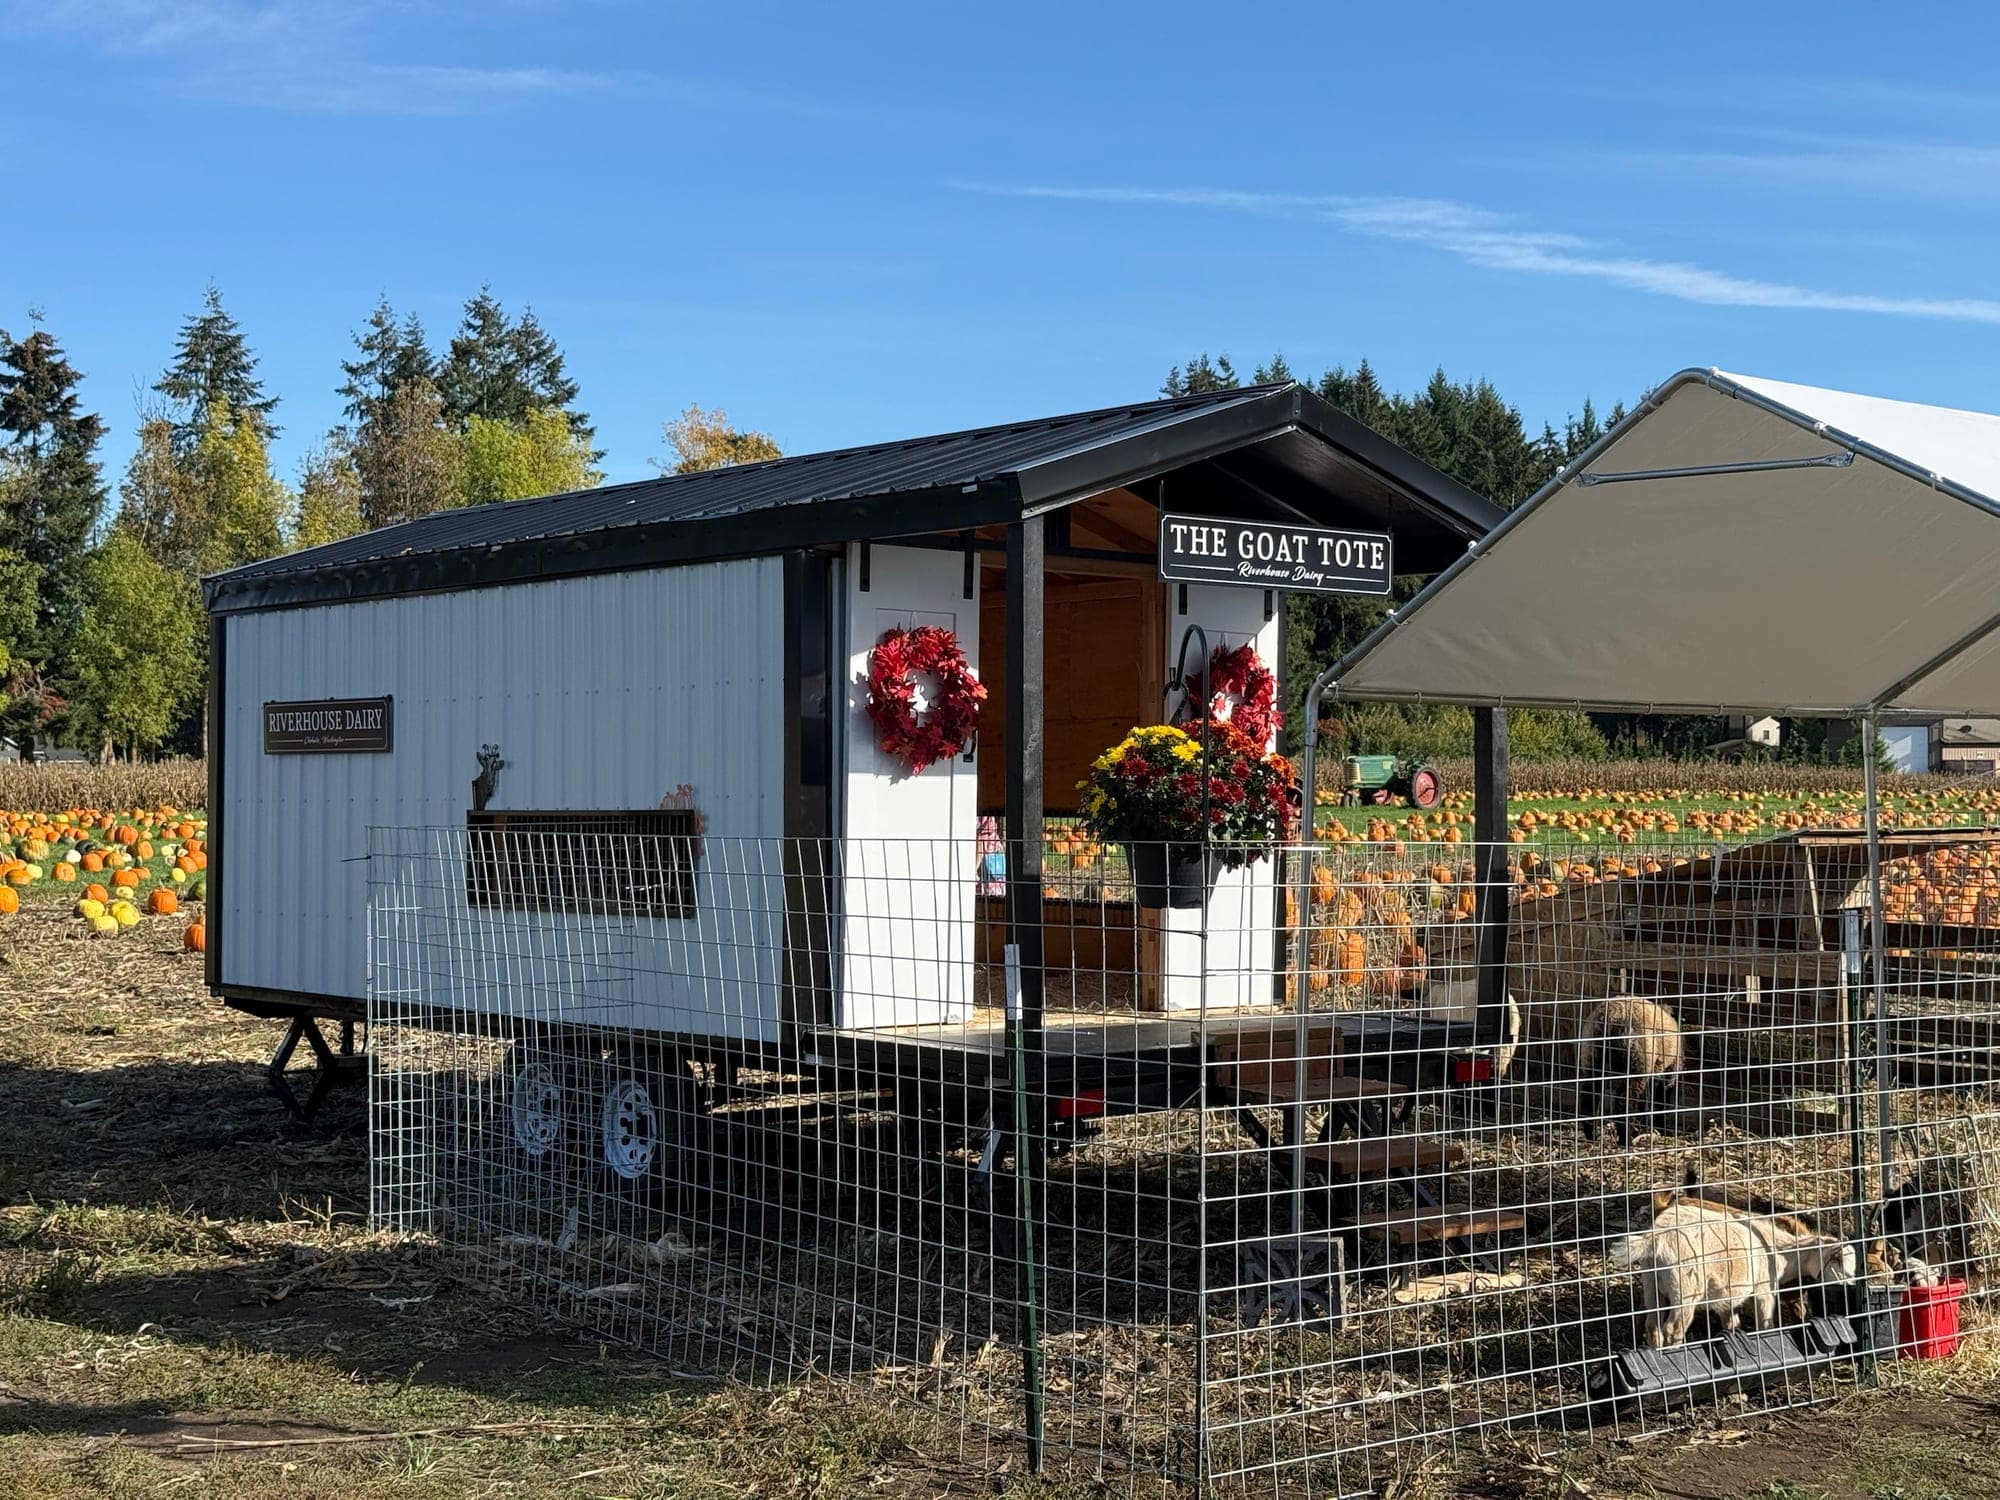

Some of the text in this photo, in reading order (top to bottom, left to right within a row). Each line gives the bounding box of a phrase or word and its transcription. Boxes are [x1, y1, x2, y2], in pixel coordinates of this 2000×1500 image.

[1170, 524, 1384, 570] THE GOAT TOTE
[1237, 561, 1325, 586] Riverhouse Dairy
[268, 709, 383, 732] RIVERHOUSE DAIRY
